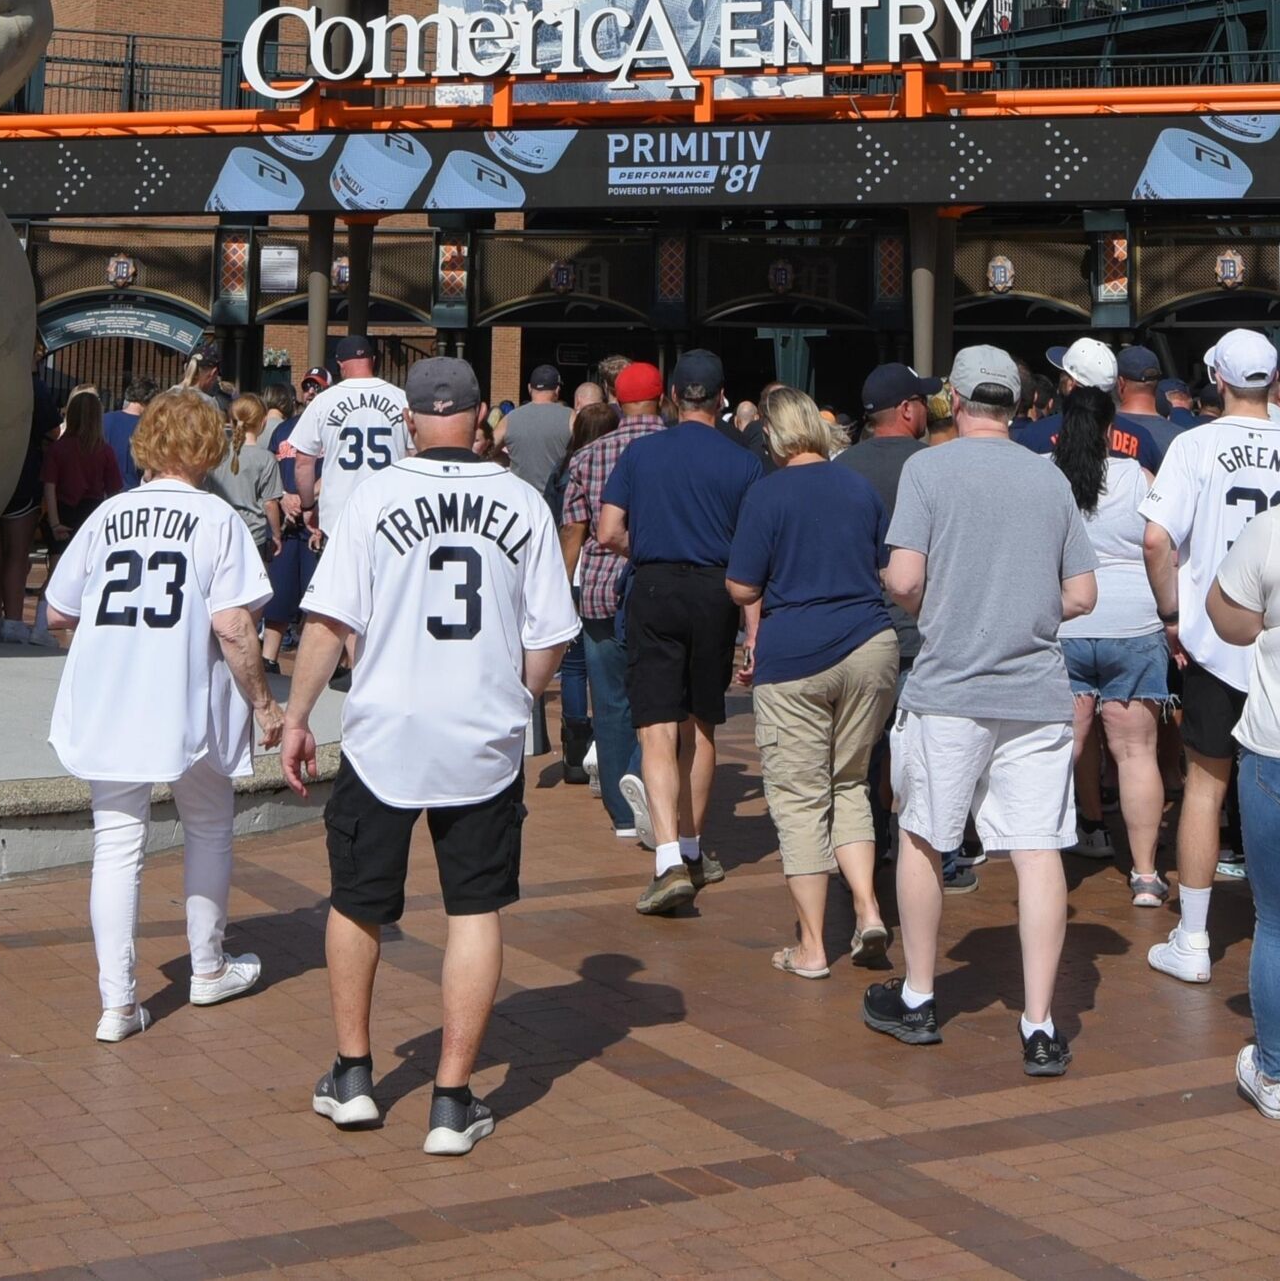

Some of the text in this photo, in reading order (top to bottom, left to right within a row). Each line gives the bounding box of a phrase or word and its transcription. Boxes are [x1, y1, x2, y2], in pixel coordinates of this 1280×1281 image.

[607, 130, 771, 163] PRIMITIV
[608, 186, 648, 195] POWERED
[650, 186, 661, 195] BY
[619, 164, 762, 193] PERFORMANCE #81
[326, 393, 404, 427] VERLANDER
[338, 426, 393, 471] 35
[104, 507, 200, 546] HORTON
[375, 491, 533, 565] TRAMMELL
[95, 549, 188, 629] 23
[426, 545, 483, 641] 3
[902, 1013, 923, 1022] HOKA
